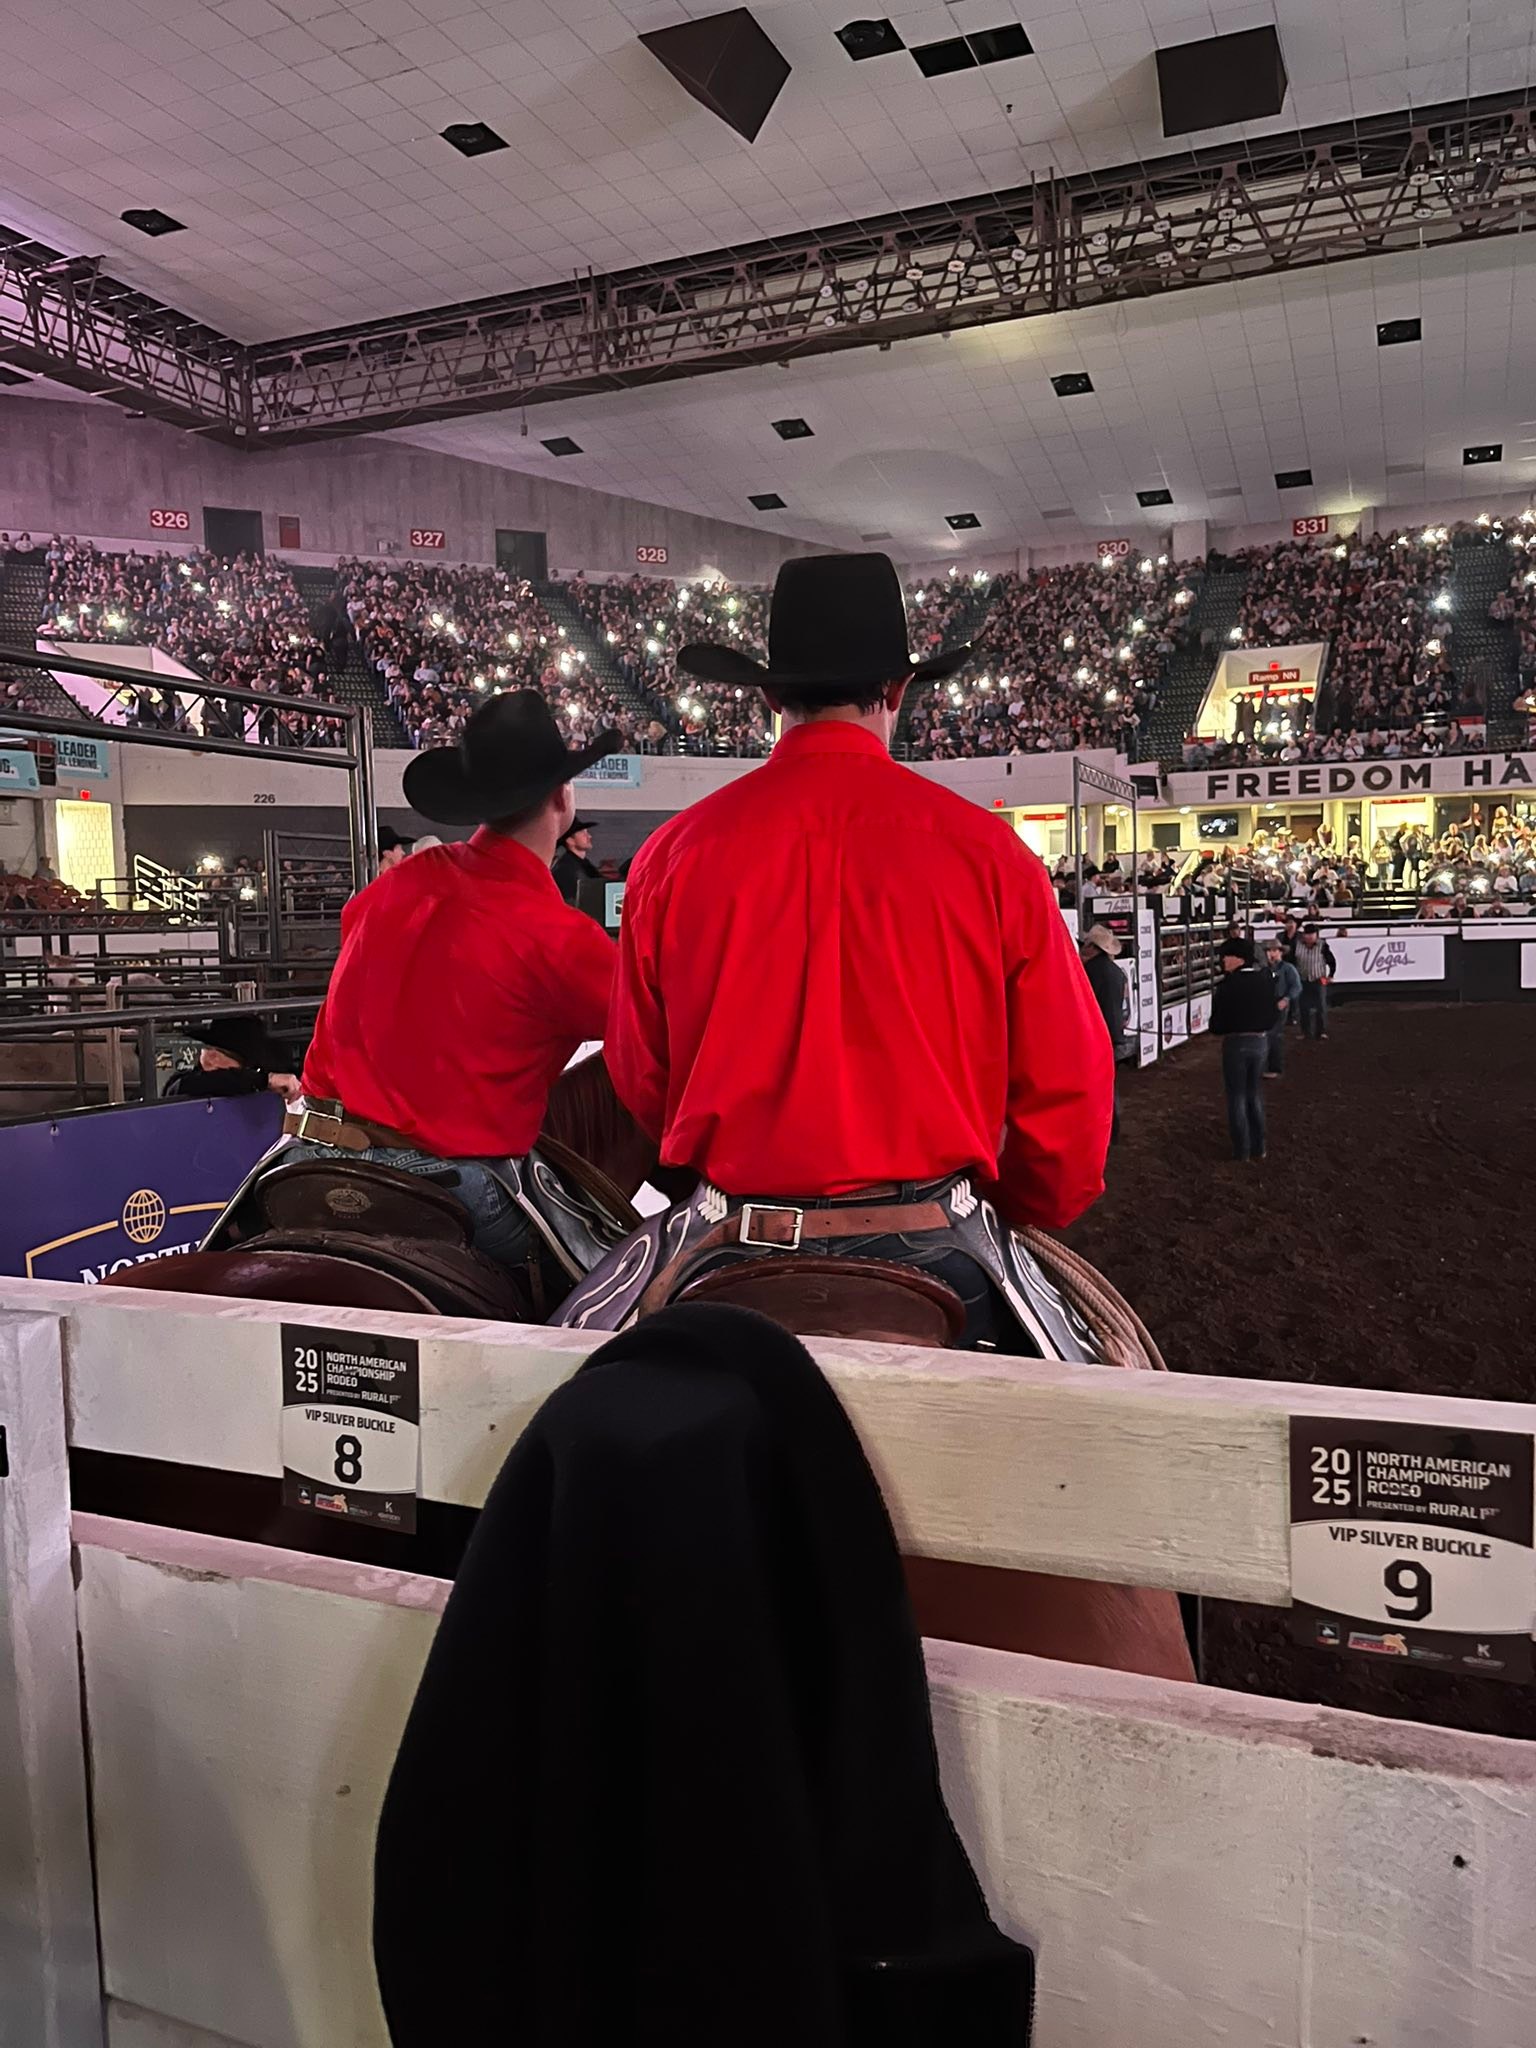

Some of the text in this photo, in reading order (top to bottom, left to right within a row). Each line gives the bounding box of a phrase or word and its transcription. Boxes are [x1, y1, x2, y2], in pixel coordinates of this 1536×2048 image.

[151, 510, 189, 529] 326
[1295, 517, 1327, 535] 331
[411, 530, 443, 547] 327
[1098, 540, 1129, 557] 330
[637, 547, 667, 563] 328
[1252, 671, 1297, 682] Ramp NN
[1207, 762, 1432, 800] FREEDOM
[253, 793, 276, 804] 226
[1354, 943, 1416, 975] Vegas
[294, 1347, 318, 1370] 20
[326, 1351, 407, 1372] NORTH AMERICAN
[295, 1370, 319, 1393] 25
[326, 1374, 358, 1387] RODEO
[361, 1391, 388, 1403] RURAL
[305, 1408, 396, 1434] VIP SILVER BUCKLE
[334, 1433, 363, 1485] 8
[1310, 1446, 1350, 1475] 20
[1366, 1451, 1511, 1478] NORTH AMERICAN
[1366, 1465, 1491, 1491] CHAMPIONSHIP
[1311, 1477, 1351, 1506] 25
[1366, 1500, 1415, 1512] PRESENTED
[1416, 1505, 1428, 1514] BY
[1429, 1502, 1478, 1519] RURAL
[1328, 1526, 1492, 1559] VIP SILVER BUCKLE
[1383, 1558, 1433, 1622] 9
